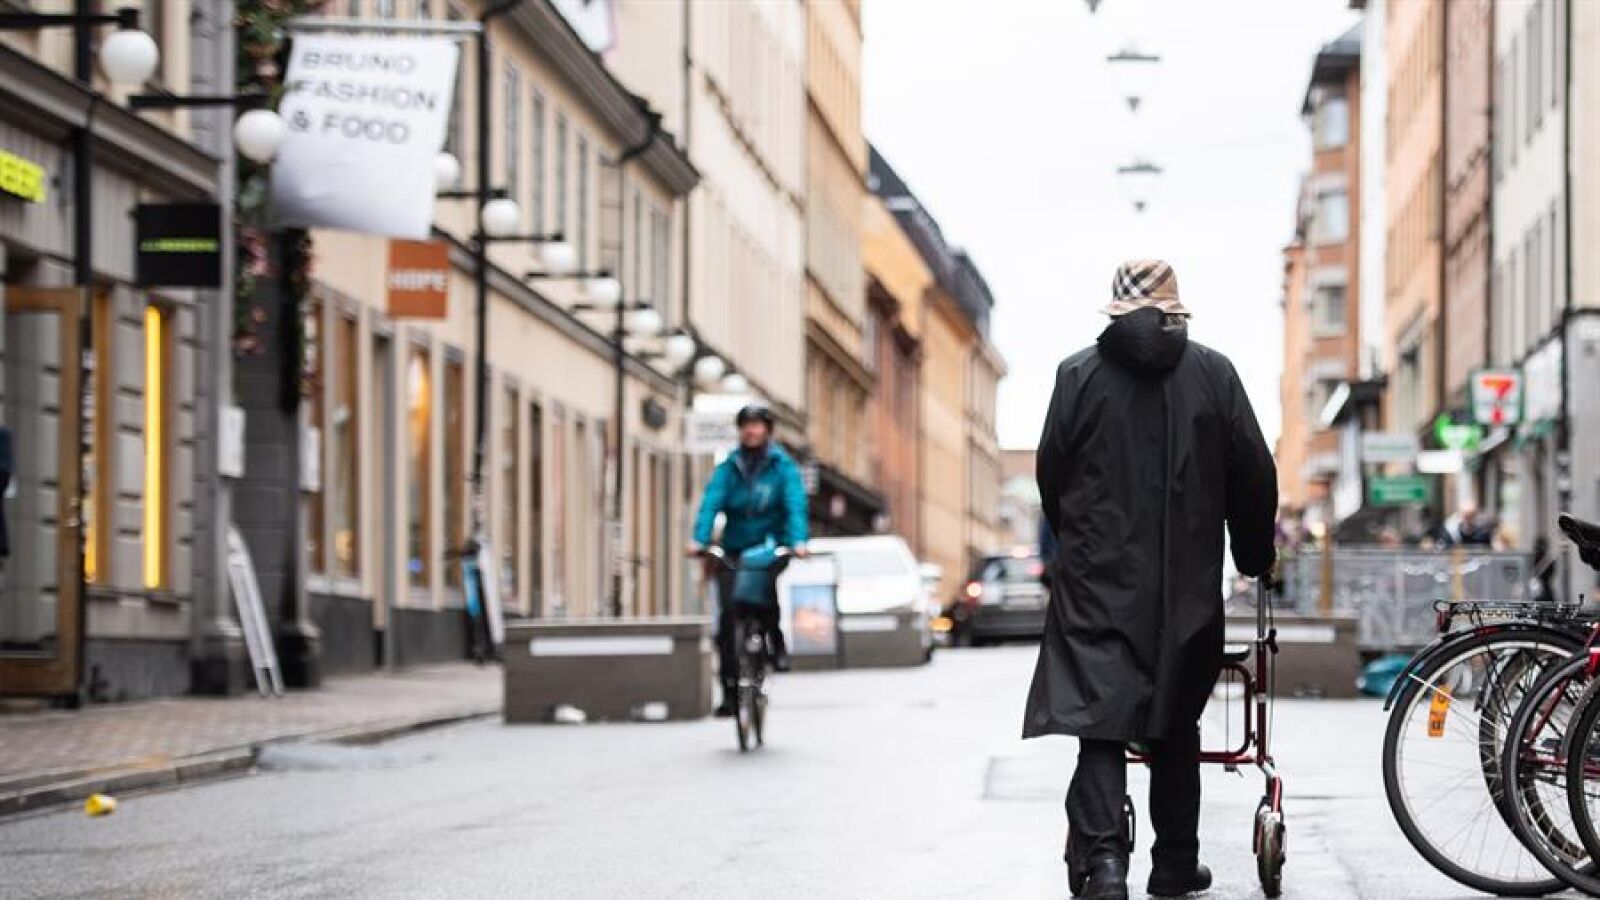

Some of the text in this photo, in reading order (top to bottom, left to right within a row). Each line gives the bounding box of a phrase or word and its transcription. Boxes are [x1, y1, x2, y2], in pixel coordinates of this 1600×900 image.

[301, 51, 416, 76] BRUNO
[292, 79, 437, 111] FASHION
[289, 108, 410, 145] & FOOD
[388, 270, 447, 292] HOPE
